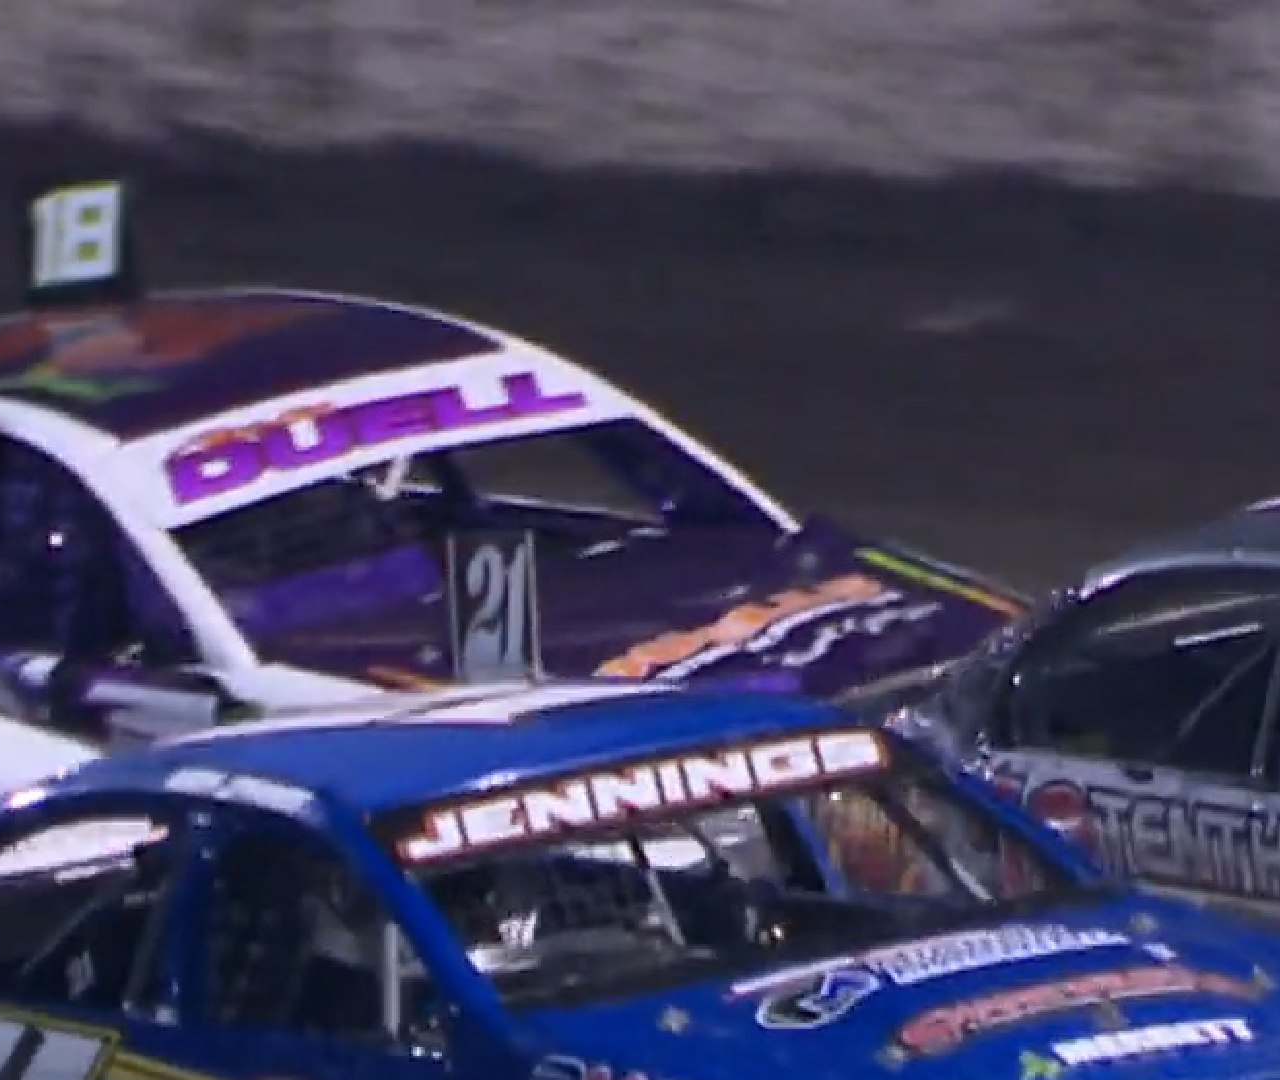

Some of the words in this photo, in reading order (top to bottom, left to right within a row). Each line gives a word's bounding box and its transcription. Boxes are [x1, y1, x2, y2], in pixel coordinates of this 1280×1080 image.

[30, 182, 118, 287] 18
[166, 371, 588, 506] DUELL
[463, 542, 528, 674] 21
